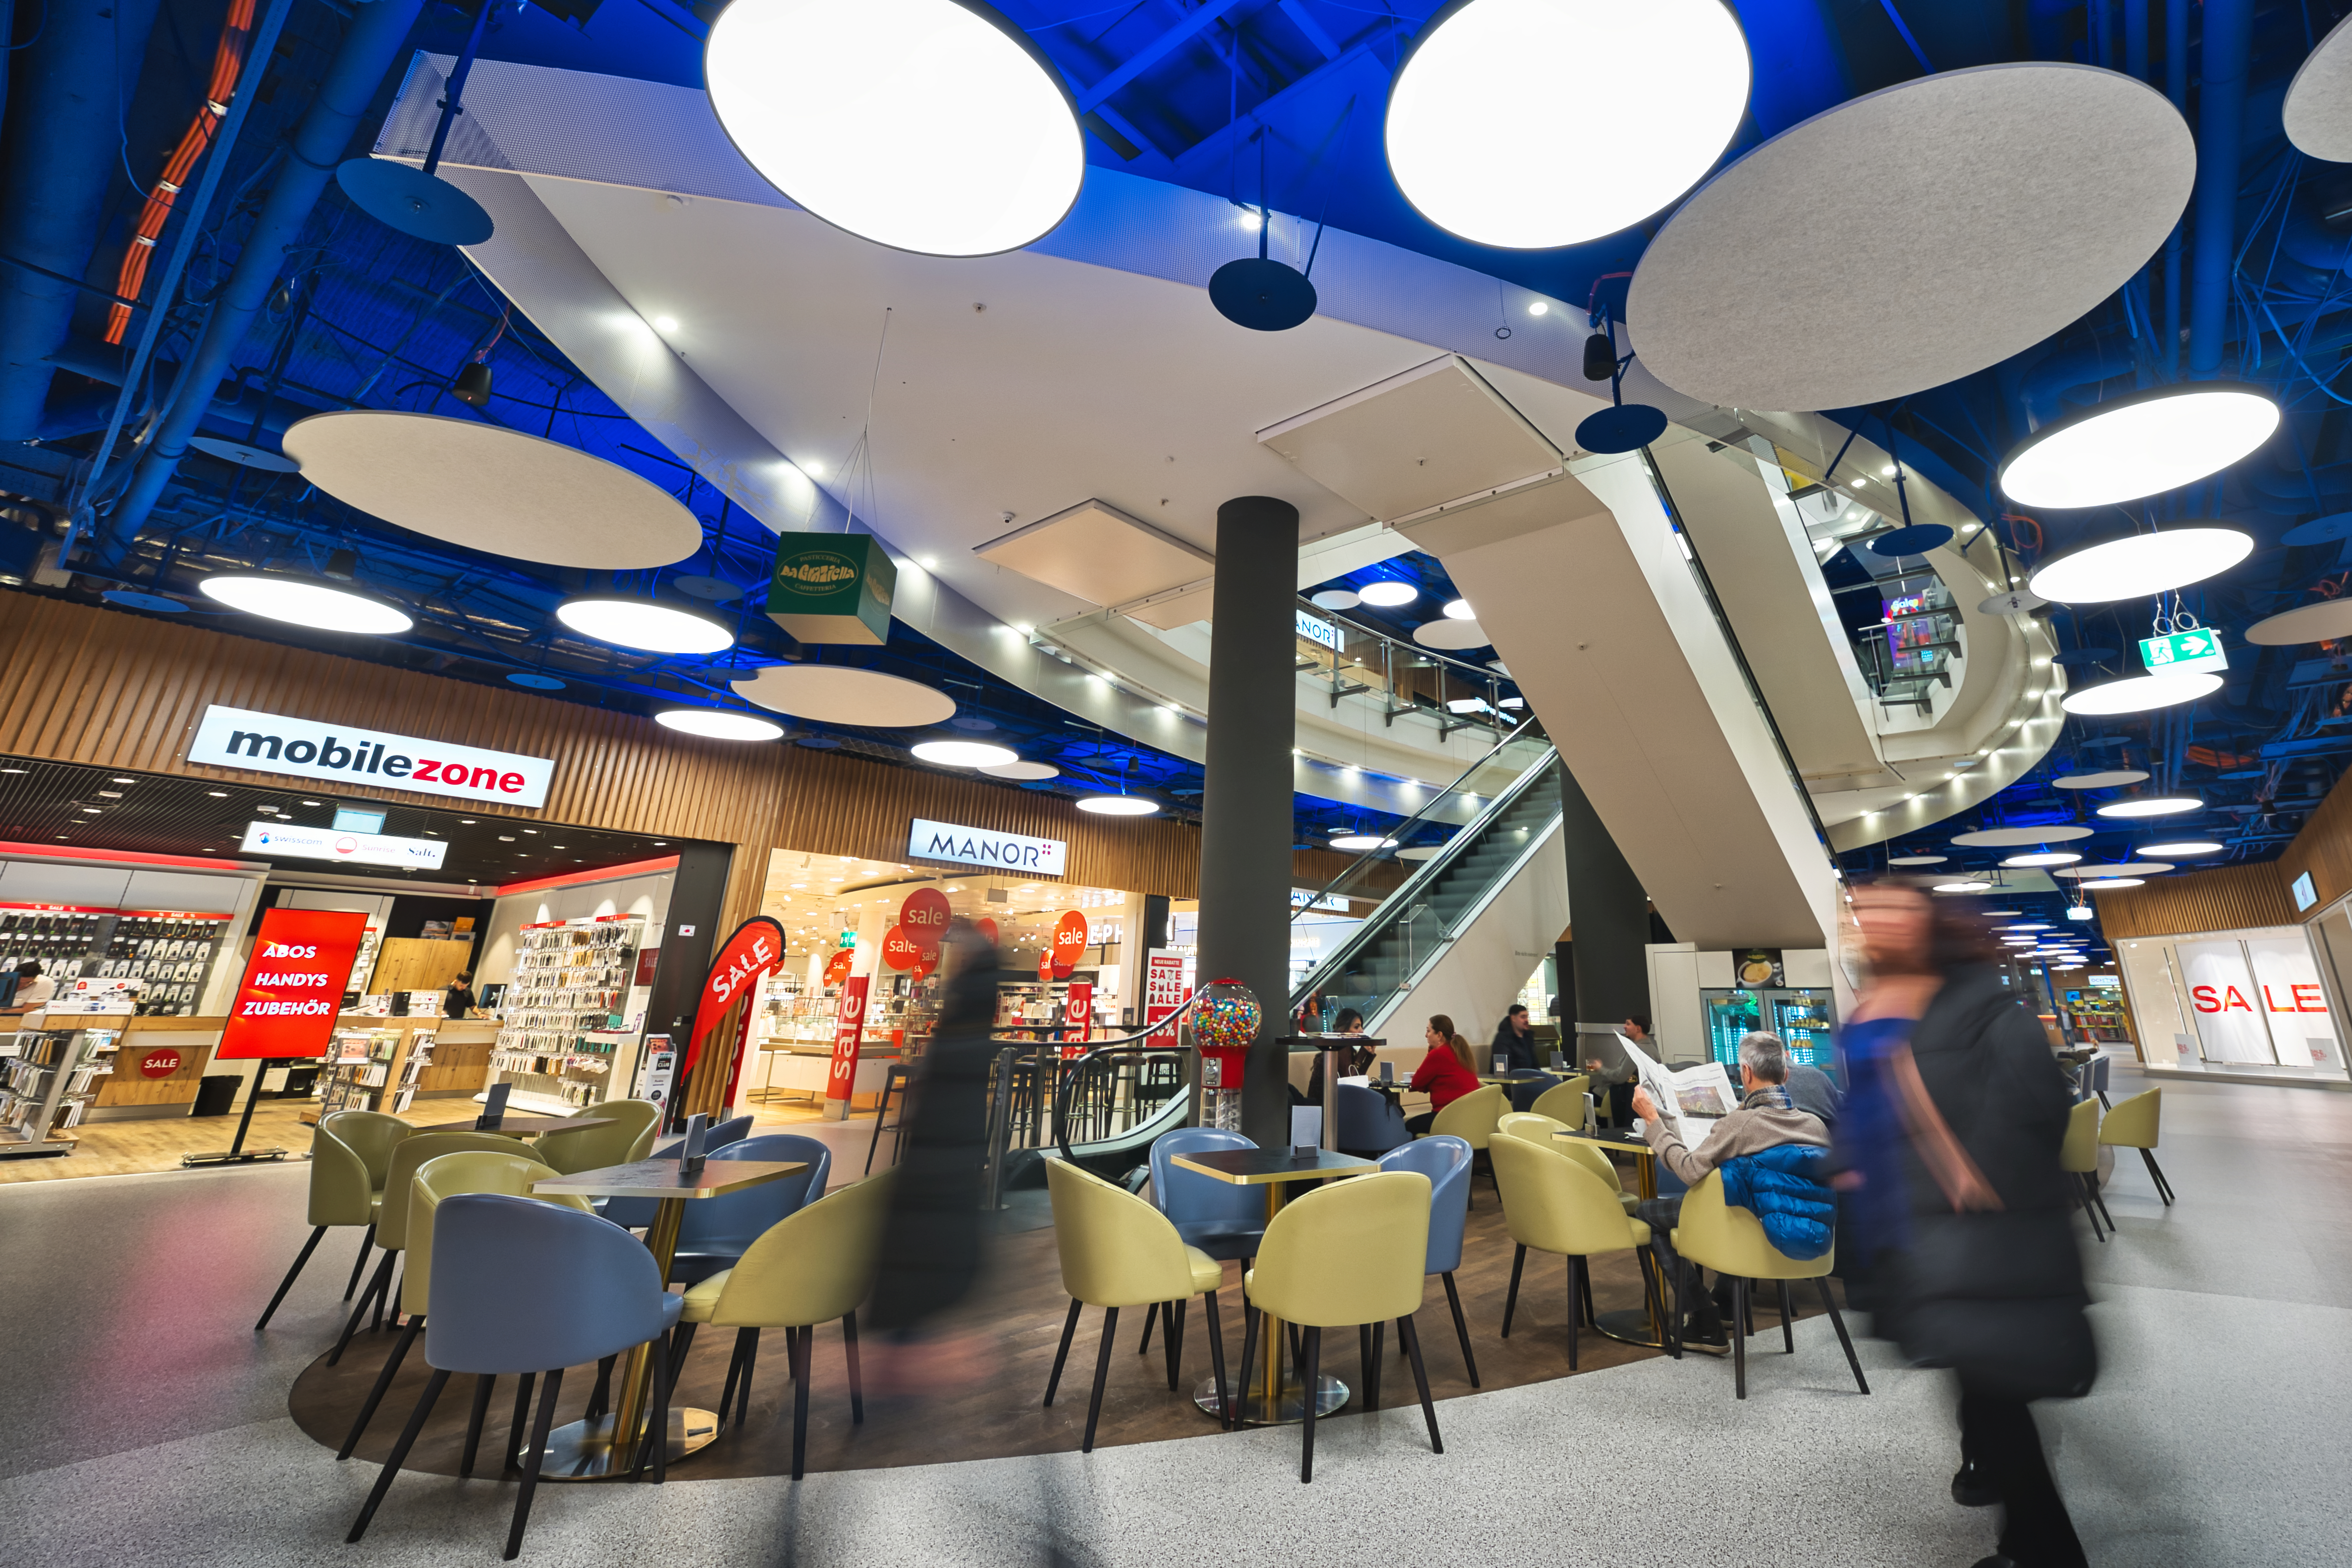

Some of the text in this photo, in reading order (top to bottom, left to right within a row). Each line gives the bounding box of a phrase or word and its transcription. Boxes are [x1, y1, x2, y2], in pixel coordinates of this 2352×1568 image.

[800, 554, 840, 564] PASTICCERIA
[795, 583, 836, 591] CAFFETTERIA
[226, 730, 525, 793] mobilezone
[274, 835, 322, 846] swisscom
[363, 844, 396, 854] Sunrise
[408, 847, 436, 858] Salt.
[928, 832, 1039, 867] MANOR
[908, 907, 943, 925] sale
[1058, 927, 1083, 945] sale
[263, 944, 317, 959] ABOS
[889, 940, 917, 953] sale
[921, 950, 937, 961] sale
[712, 936, 773, 1003] SALE
[1150, 969, 1182, 981] SAE
[255, 973, 328, 986] HANDYS
[1149, 981, 1181, 992] SLE
[1149, 993, 1180, 1005] ALE
[2192, 984, 2328, 1013] SALE
[242, 999, 331, 1016] ZUBEHÖR
[834, 994, 862, 1081] sale
[144, 1058, 178, 1069] SALE
